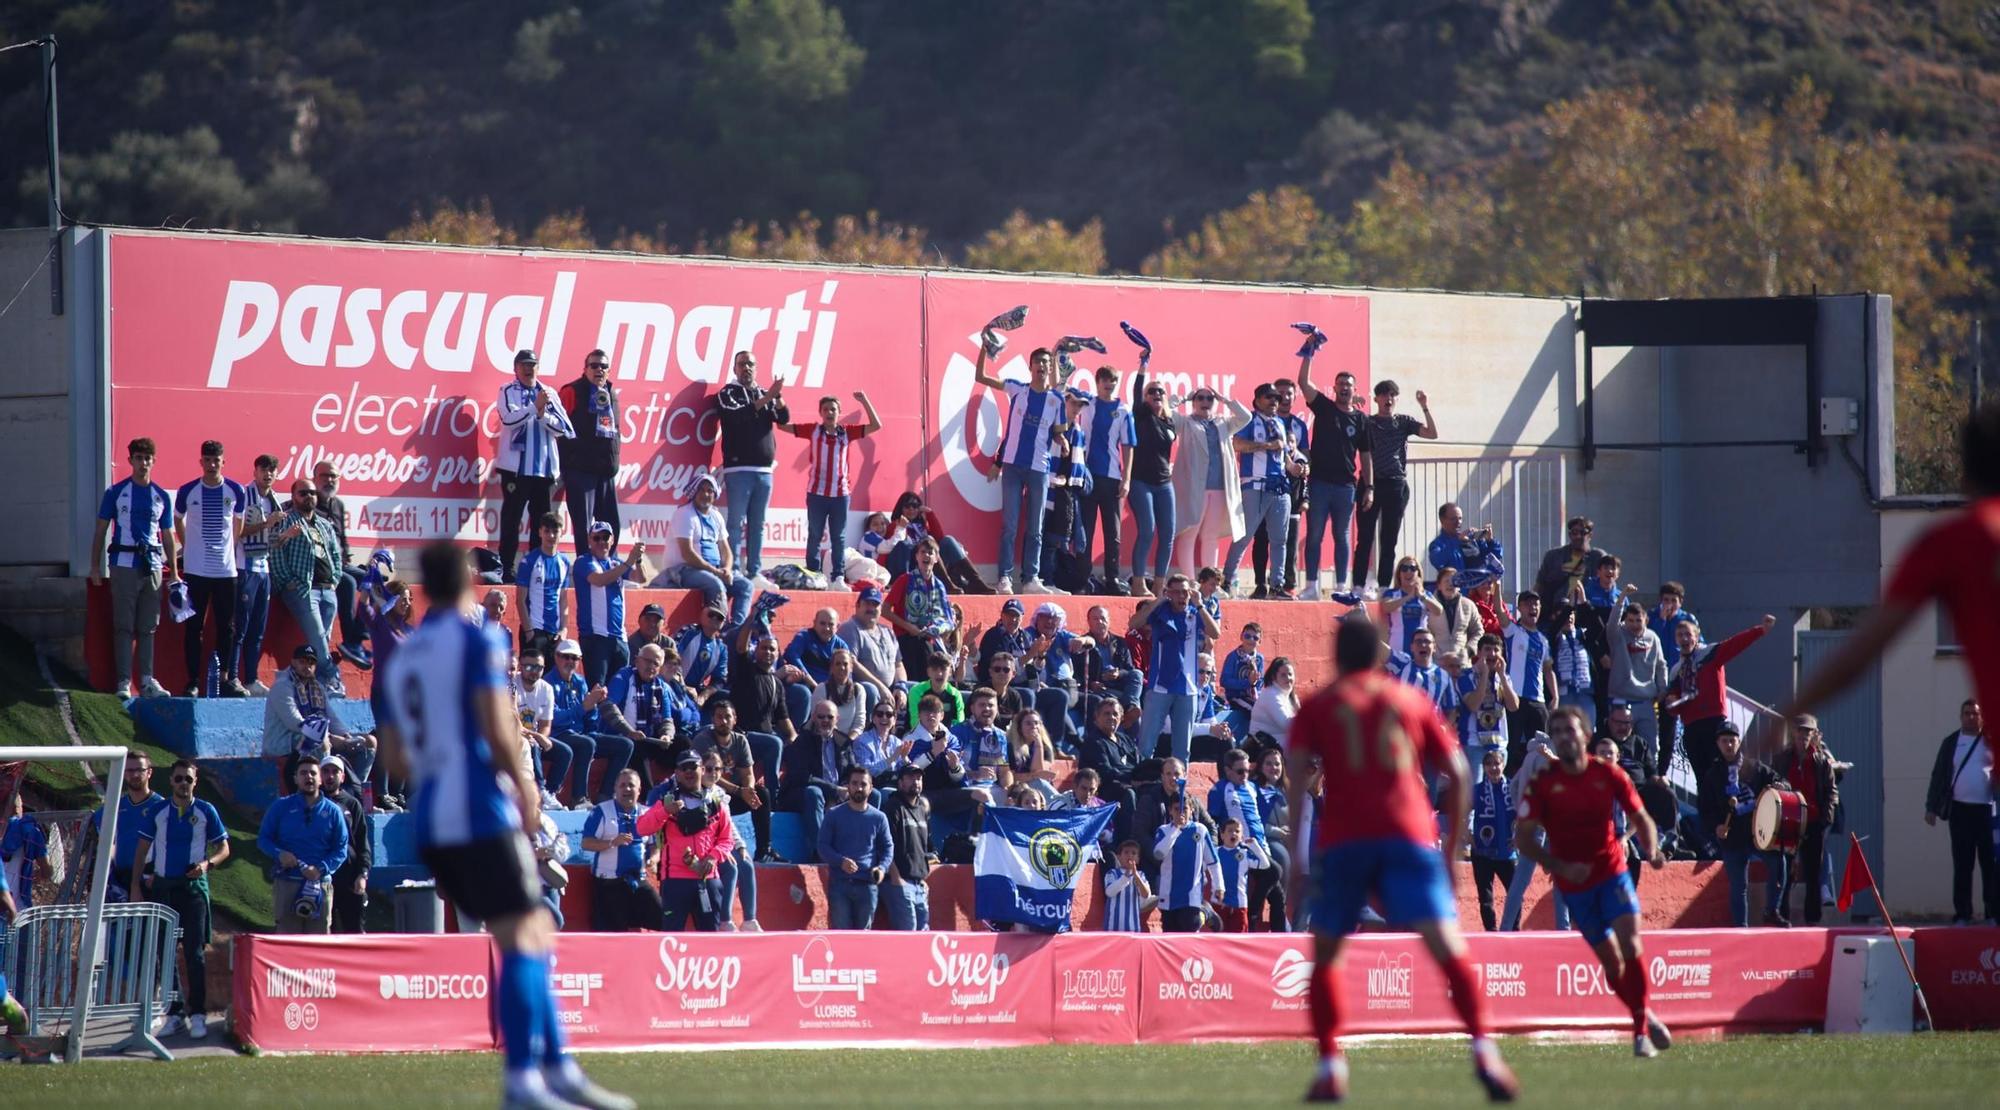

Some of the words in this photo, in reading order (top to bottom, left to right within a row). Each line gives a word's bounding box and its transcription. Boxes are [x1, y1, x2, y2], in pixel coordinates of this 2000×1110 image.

[207, 271, 577, 388] pascual
[356, 505, 424, 538] Azzati,
[430, 507, 449, 534] 11
[656, 936, 741, 1007] Sirep
[928, 933, 1009, 1004] Sirep
[1951, 970, 1986, 985] EXPA
[425, 975, 488, 999] DECCO
[1159, 983, 1185, 1000] EXPA
[1189, 983, 1233, 1000] GLOBAL
[1368, 968, 1411, 997] NOVARSE
[1486, 981, 1526, 997] SPORTS
[814, 1005, 857, 1018] LLORENS
